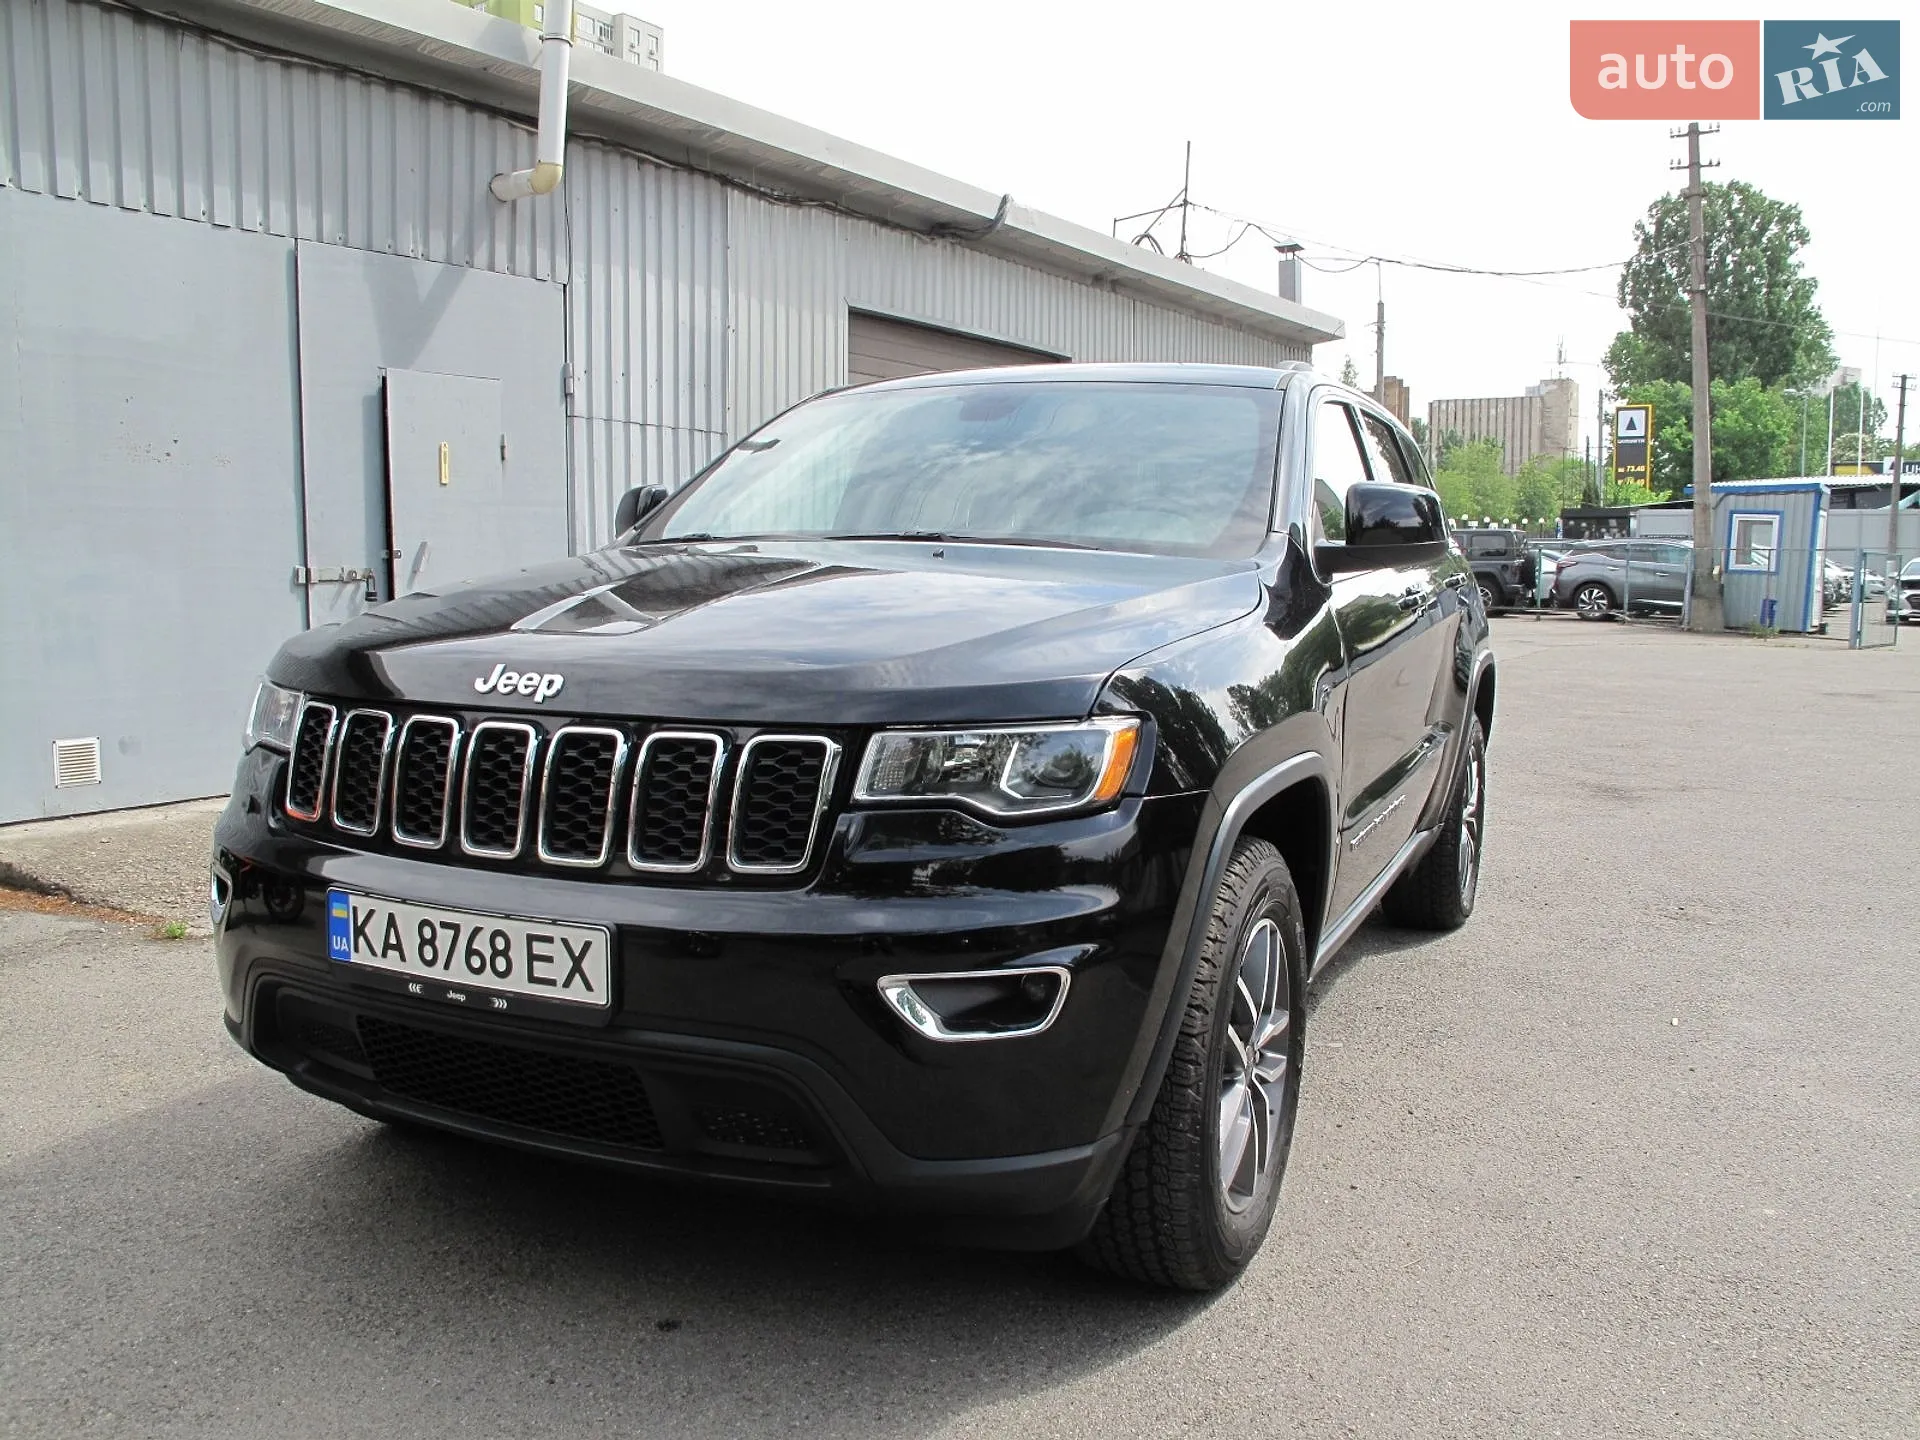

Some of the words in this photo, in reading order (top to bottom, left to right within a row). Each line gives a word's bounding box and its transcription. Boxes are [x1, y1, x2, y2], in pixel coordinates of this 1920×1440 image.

[474, 663, 564, 704] Jeep
[332, 935, 349, 952] UA
[352, 905, 407, 963] KA
[416, 917, 513, 979] 8768
[525, 932, 594, 993] EX
[446, 990, 466, 1003] Jeep
